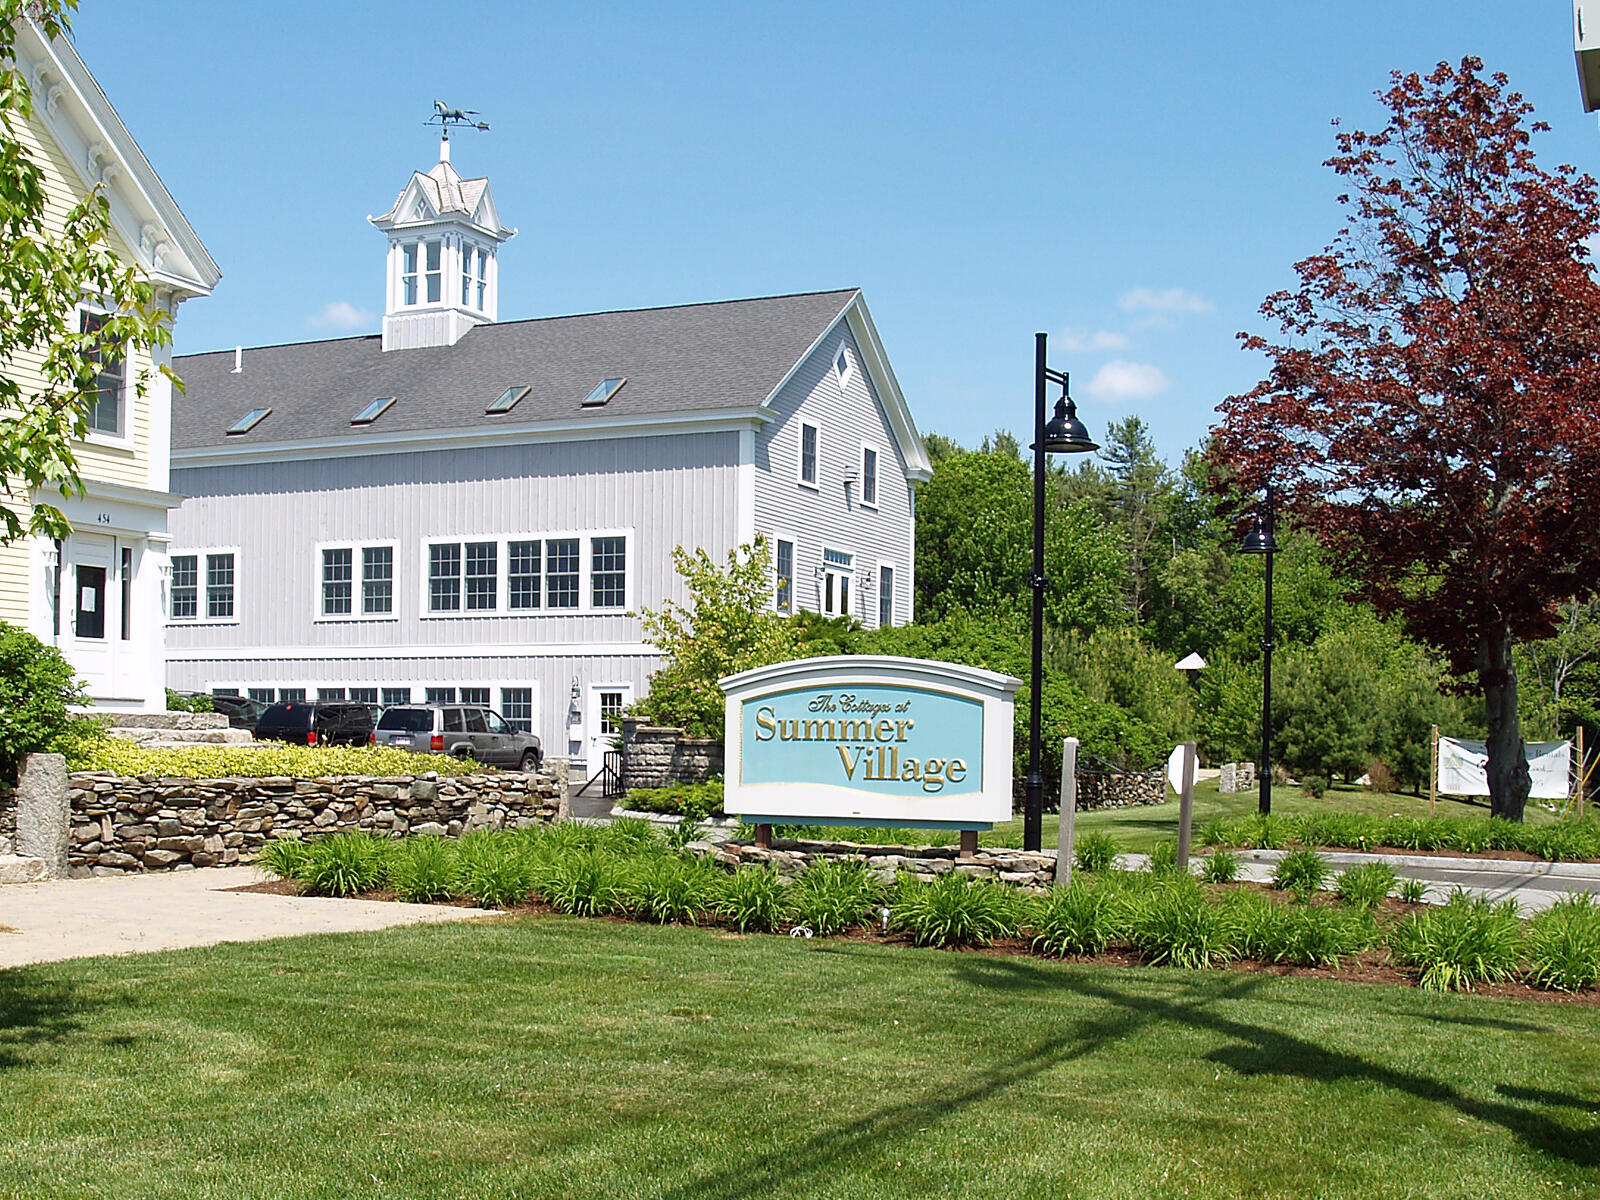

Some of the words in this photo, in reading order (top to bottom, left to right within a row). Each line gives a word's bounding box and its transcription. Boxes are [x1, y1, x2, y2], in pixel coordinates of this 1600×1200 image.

[97, 512, 110, 524] 454
[808, 694, 837, 712] The
[838, 693, 892, 720] Cottages
[894, 699, 911, 713] at
[755, 706, 914, 742] Summer
[836, 745, 967, 792] Village
